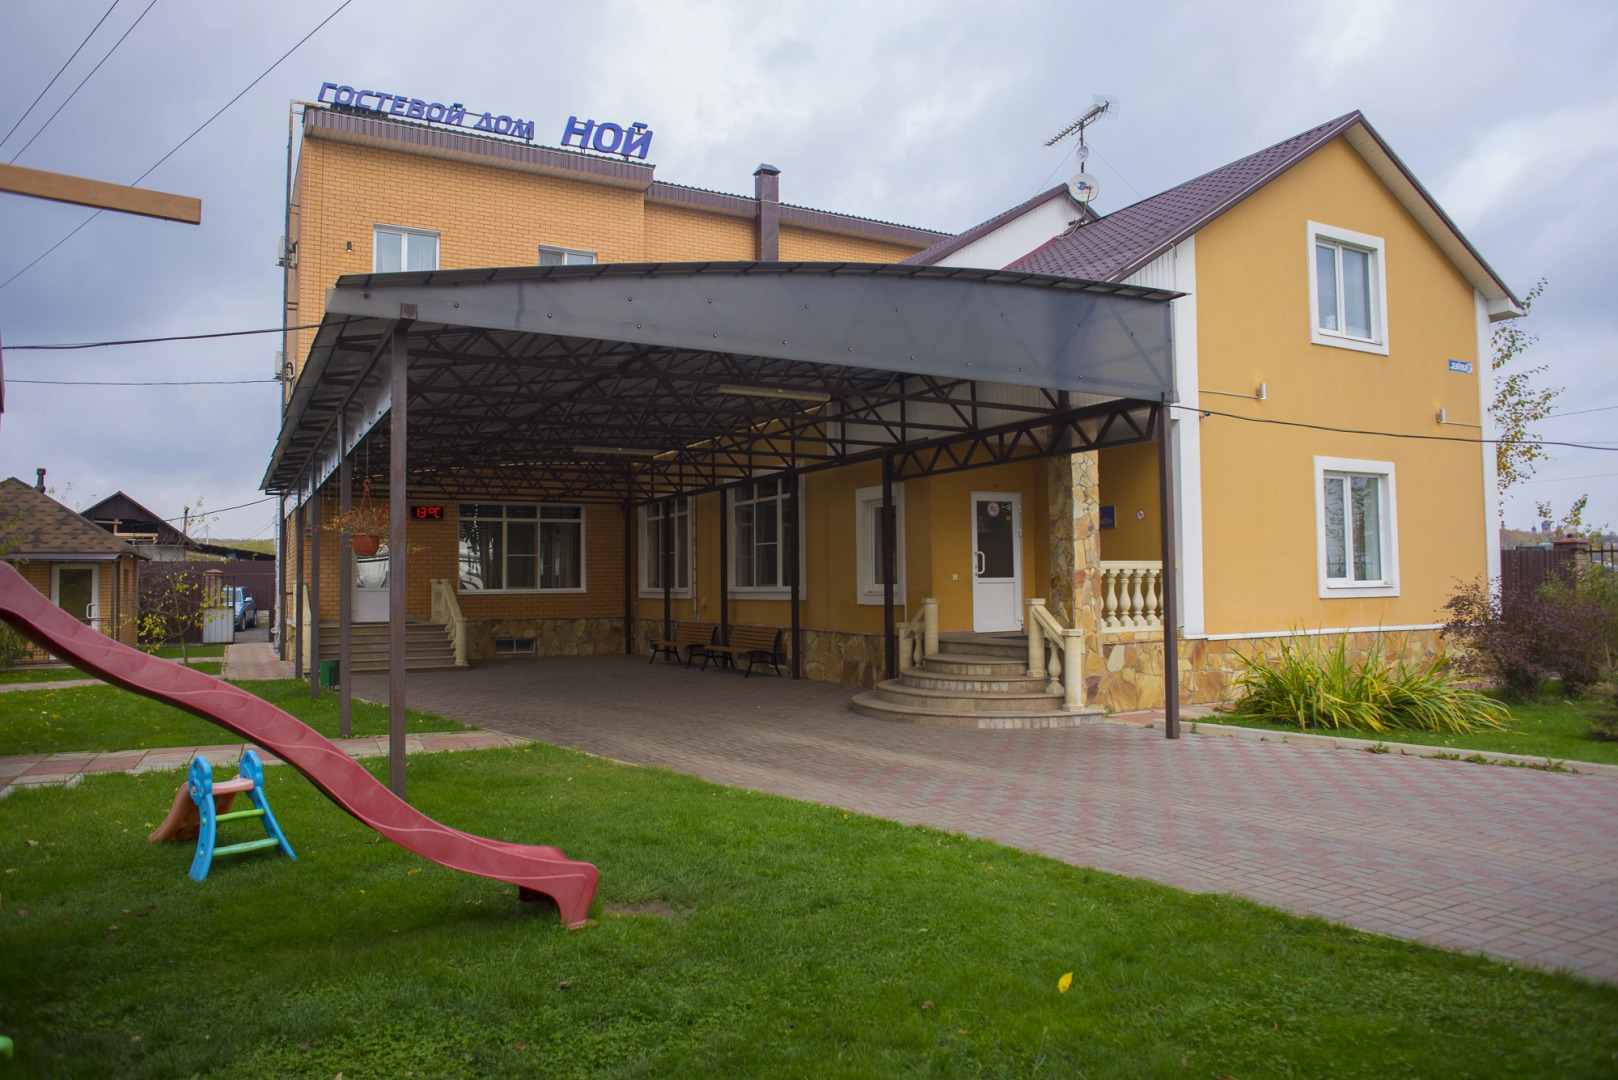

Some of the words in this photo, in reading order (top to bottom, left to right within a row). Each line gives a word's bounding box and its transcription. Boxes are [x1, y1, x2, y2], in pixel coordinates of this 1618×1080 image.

[318, 82, 466, 126] ГОСТЕВОЙ
[474, 112, 535, 140] ДОМ
[561, 116, 654, 159] НОЙ
